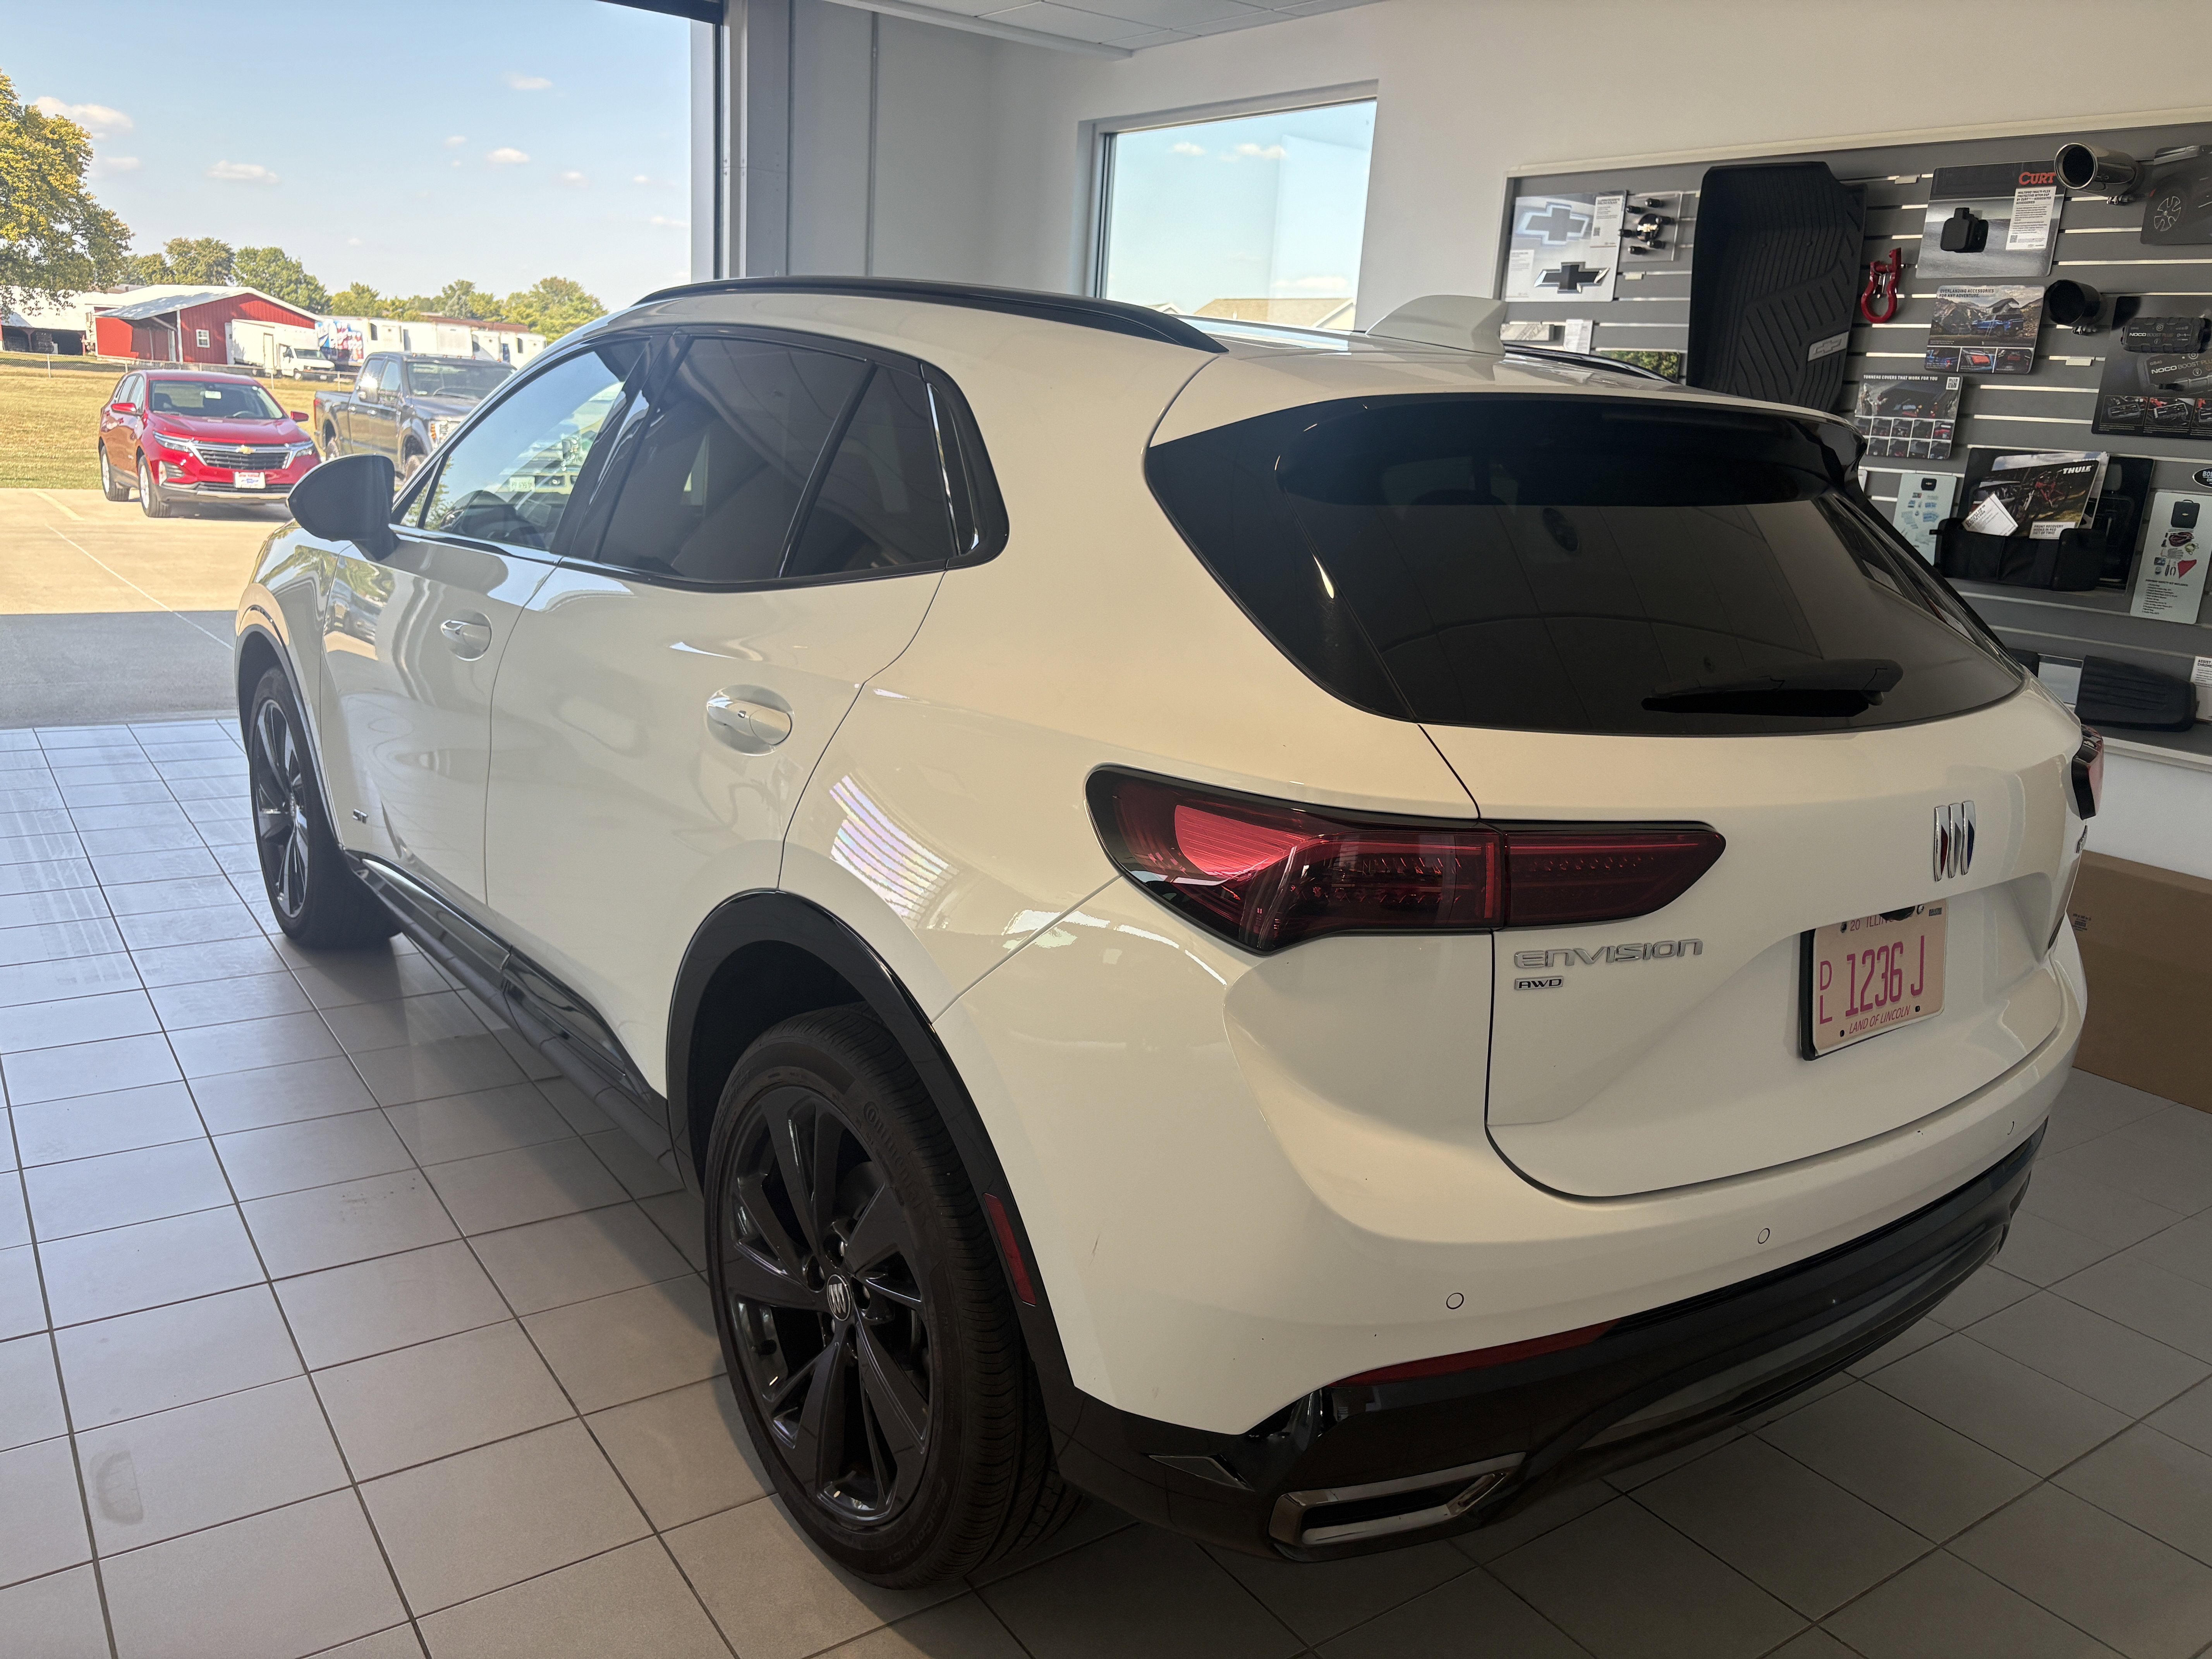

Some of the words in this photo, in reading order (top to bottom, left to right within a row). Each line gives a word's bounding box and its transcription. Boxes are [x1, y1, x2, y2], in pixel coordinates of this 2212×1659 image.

[2019, 172, 2056, 185] CURT
[2151, 365, 2178, 374] NOCO
[2178, 361, 2200, 370] BOOST
[2063, 465, 2092, 474] THULE
[1850, 919, 1860, 931] 20
[1515, 938, 1703, 968] ENVISION
[1845, 941, 1904, 1017] 1236
[1910, 935, 1925, 996] J
[1518, 978, 1563, 989] AWD
[1849, 1018, 1869, 1034] LAND
[1869, 1014, 1880, 1027] OF
[1880, 1005, 1911, 1024] LINCOLN
